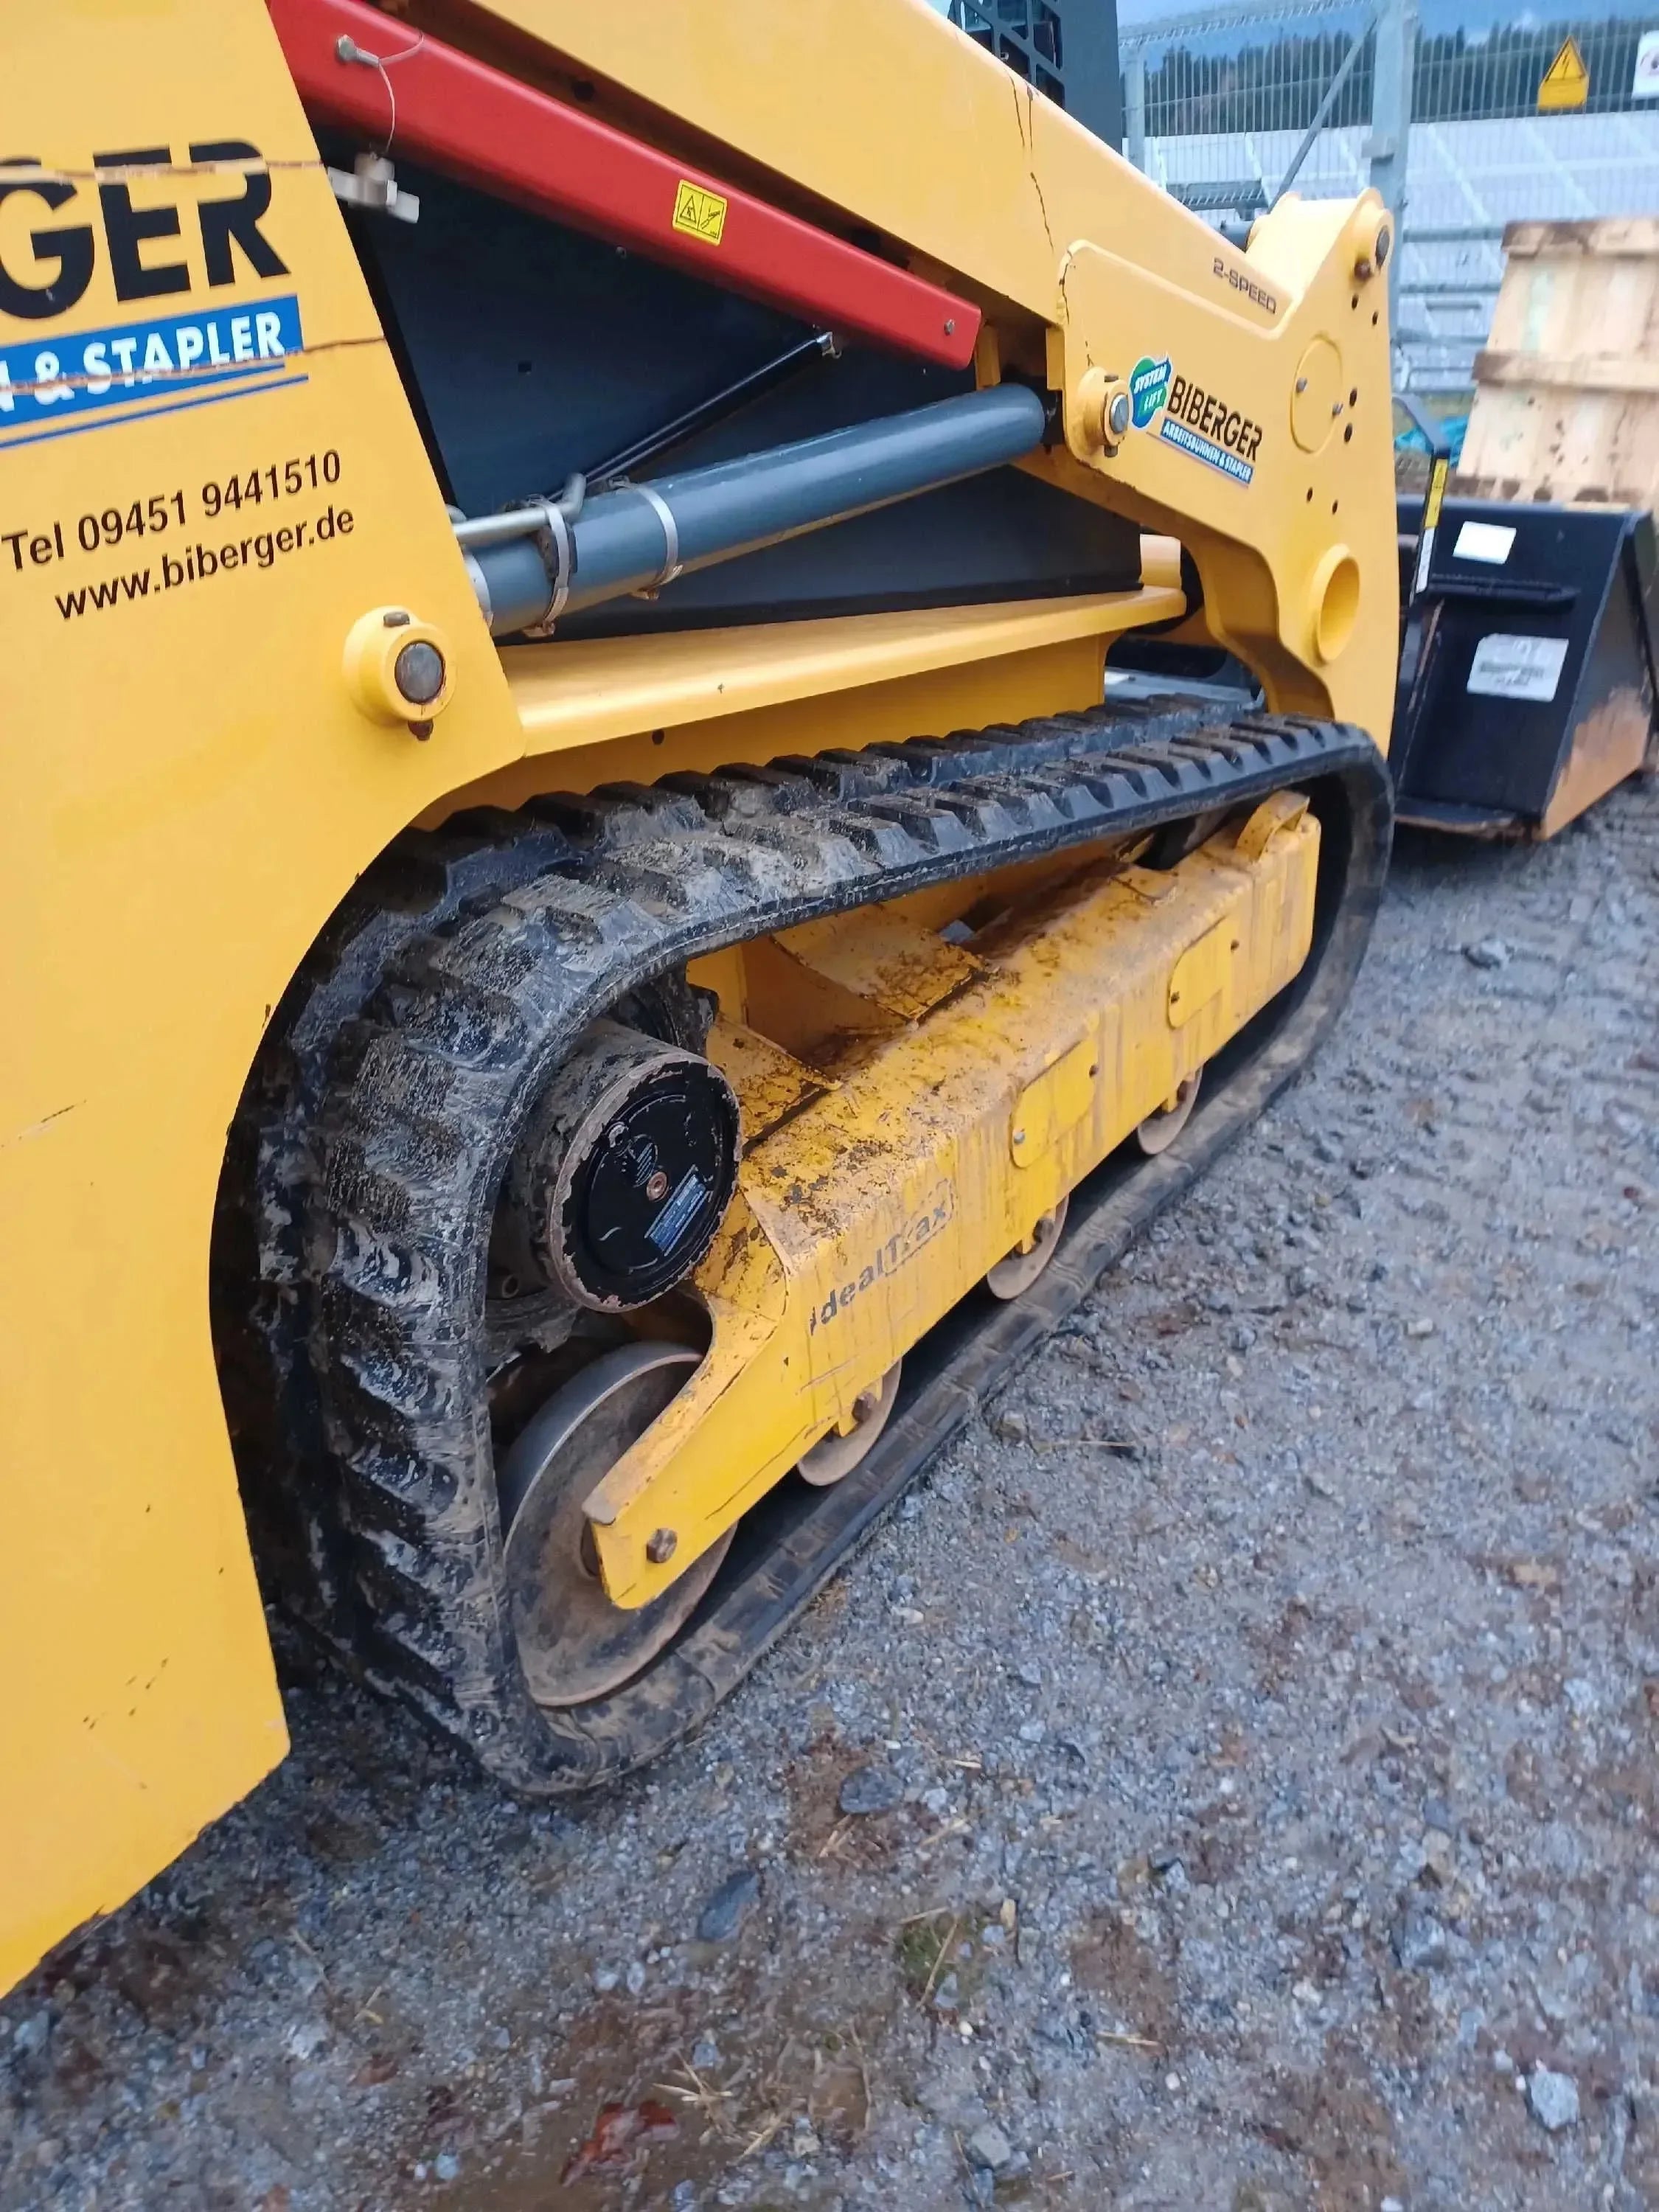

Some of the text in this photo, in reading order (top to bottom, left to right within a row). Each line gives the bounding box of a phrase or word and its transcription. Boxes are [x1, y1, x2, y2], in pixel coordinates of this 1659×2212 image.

[0, 138, 291, 321] GER
[1213, 257, 1277, 314] 2-SPEED
[35, 351, 74, 405] &
[83, 311, 285, 394] STAPLER
[1144, 389, 1163, 411] LIFT
[1166, 375, 1263, 461] BIBERGER
[1, 448, 341, 572] Tel 09451 9441510
[55, 504, 355, 619] www.biberger.de
